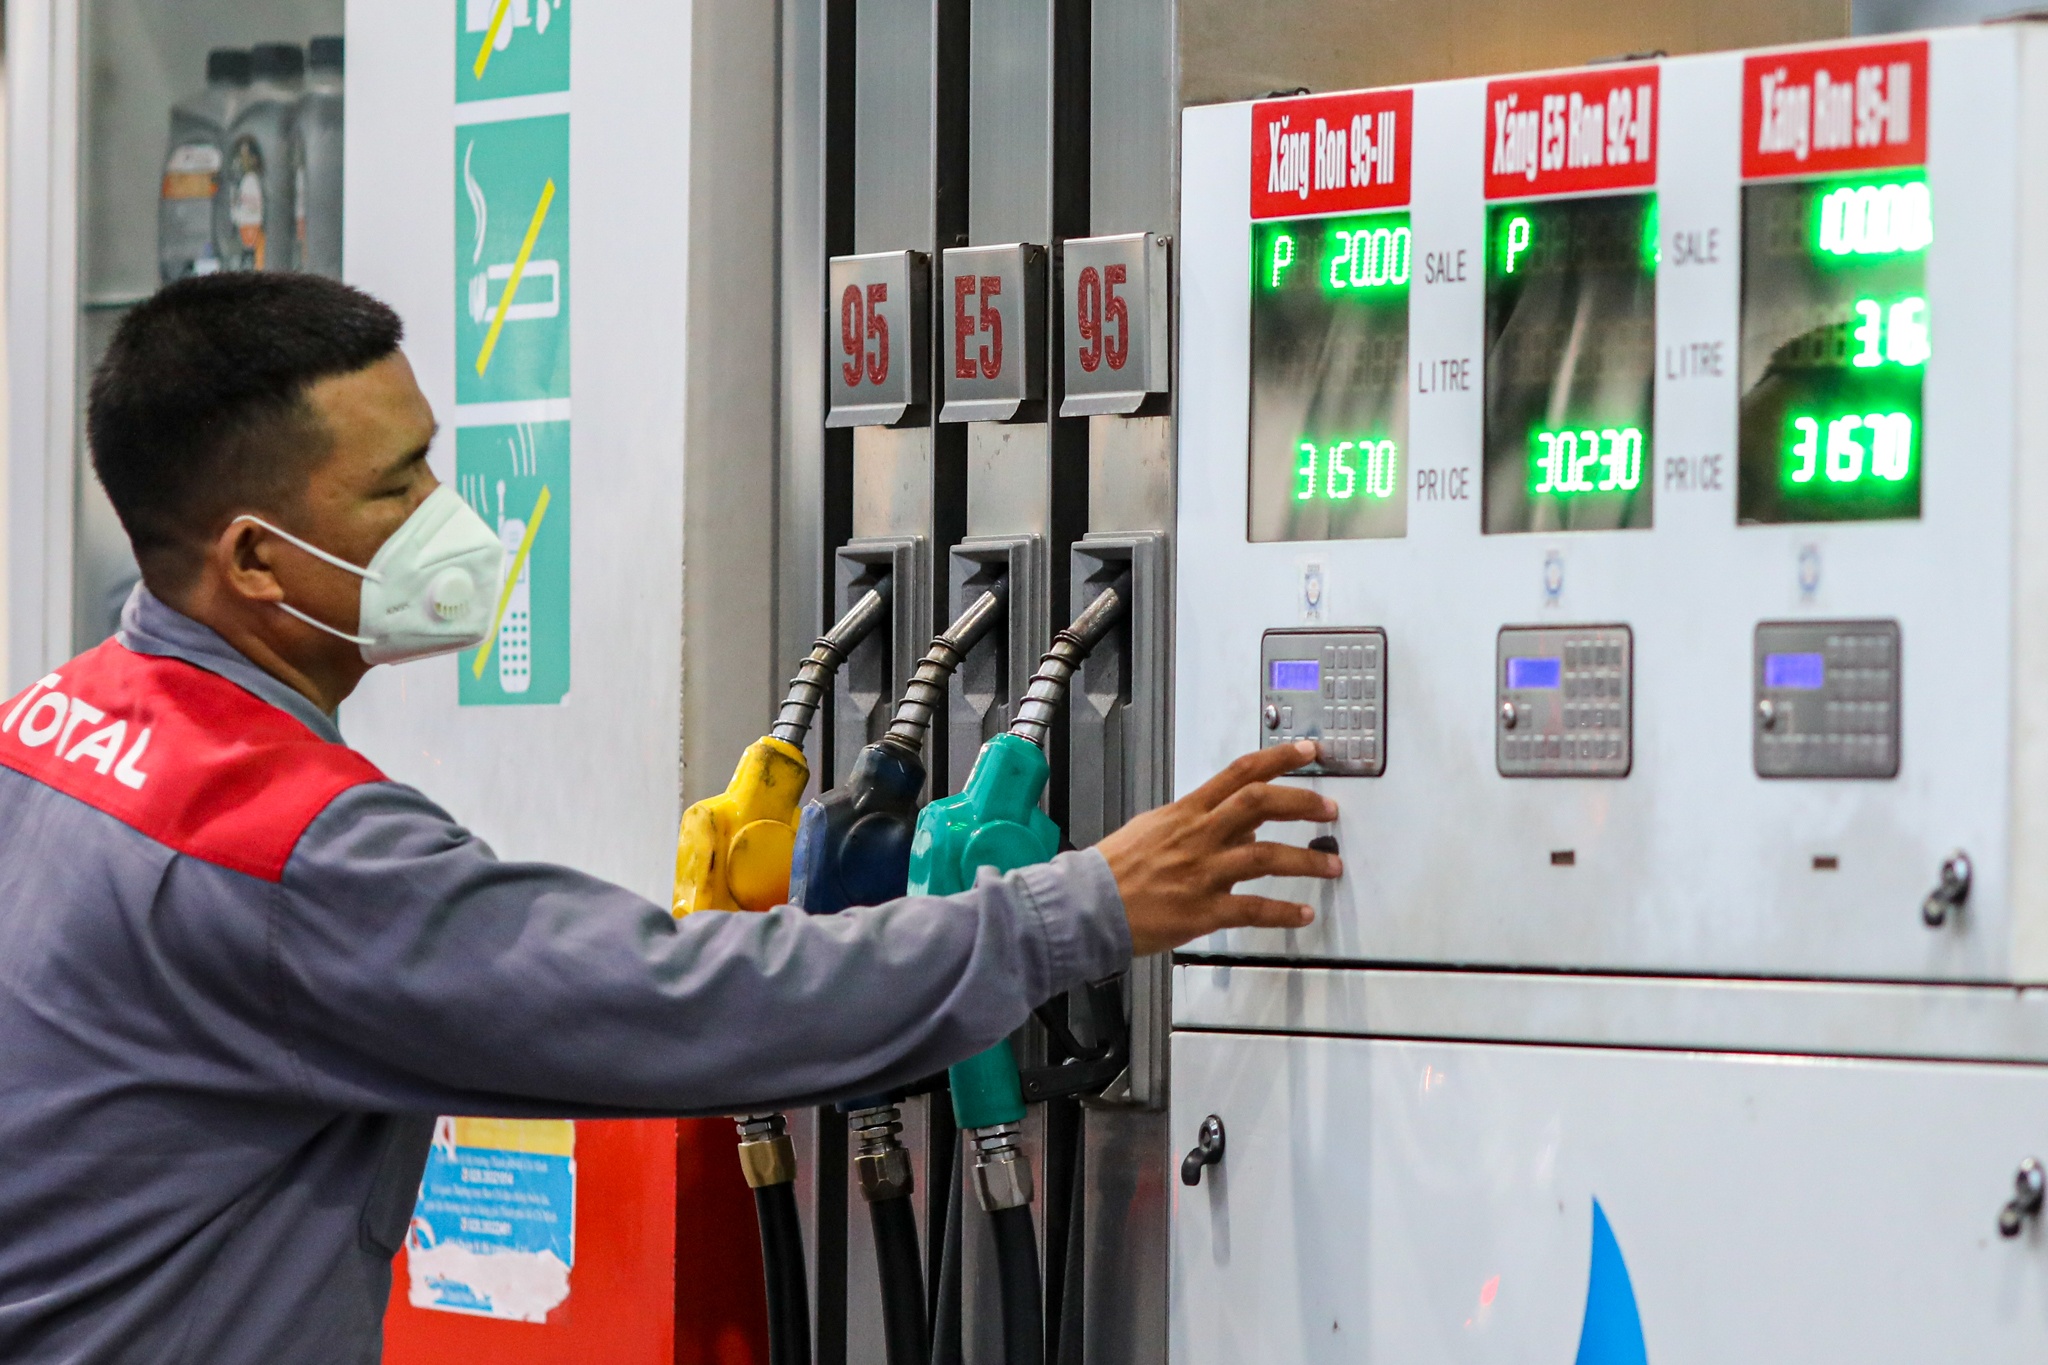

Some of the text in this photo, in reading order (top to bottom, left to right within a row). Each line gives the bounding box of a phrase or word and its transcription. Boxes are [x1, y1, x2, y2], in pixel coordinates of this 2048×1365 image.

[1268, 110, 1396, 200] Xăng Ron 95-III
[1492, 84, 1652, 182] Xăng E5 Ron 92-II
[1272, 235, 1295, 288] P
[1425, 250, 1467, 284] SALE
[1506, 217, 1530, 273] P
[1672, 227, 1719, 266] SALE
[841, 283, 889, 387] 95
[954, 275, 1003, 380] E5
[1077, 263, 1129, 373] 95
[1418, 358, 1470, 393] LITRE
[1665, 341, 1724, 380] LITRE
[1417, 467, 1470, 501] PRICE
[1664, 453, 1723, 492] PRICE
[2, 673, 151, 790] TOTAL
